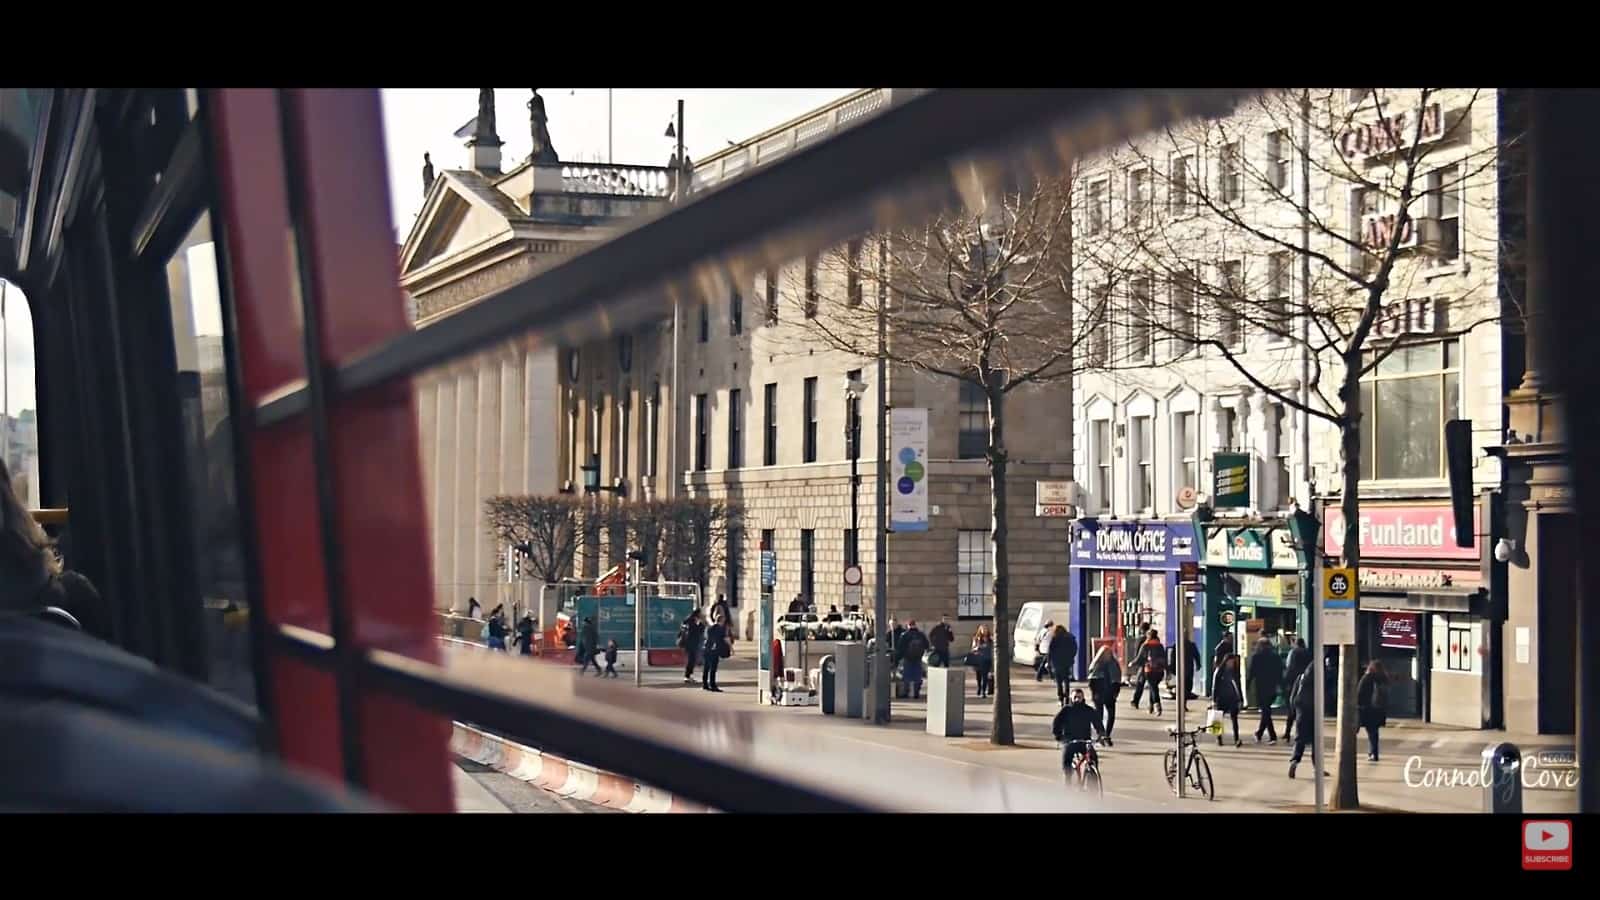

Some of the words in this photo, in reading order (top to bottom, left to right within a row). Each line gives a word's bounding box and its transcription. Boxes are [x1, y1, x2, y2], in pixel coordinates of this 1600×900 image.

[1374, 297, 1431, 336] ISIT
[1096, 528, 1133, 552] TOURISM
[1134, 527, 1167, 552] OFFICE
[1359, 516, 1444, 546] Funland
[1228, 542, 1264, 560] Londis
